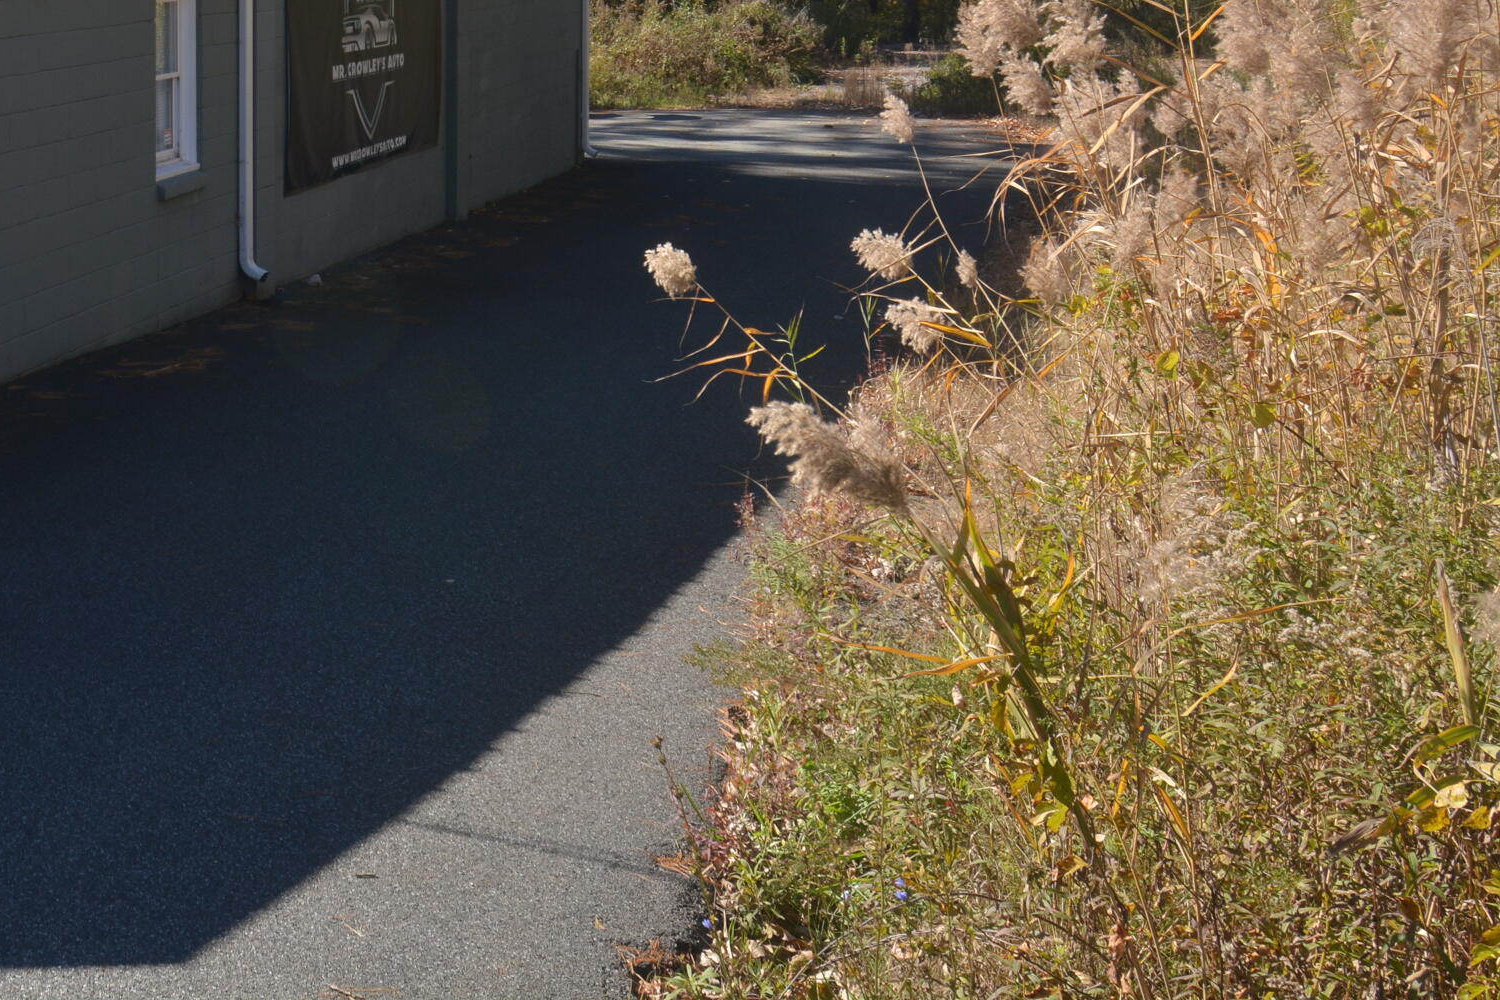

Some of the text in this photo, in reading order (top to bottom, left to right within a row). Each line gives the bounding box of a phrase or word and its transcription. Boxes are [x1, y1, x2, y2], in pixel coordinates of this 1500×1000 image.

[332, 53, 405, 80] MR. CROWLEY'S AUTO
